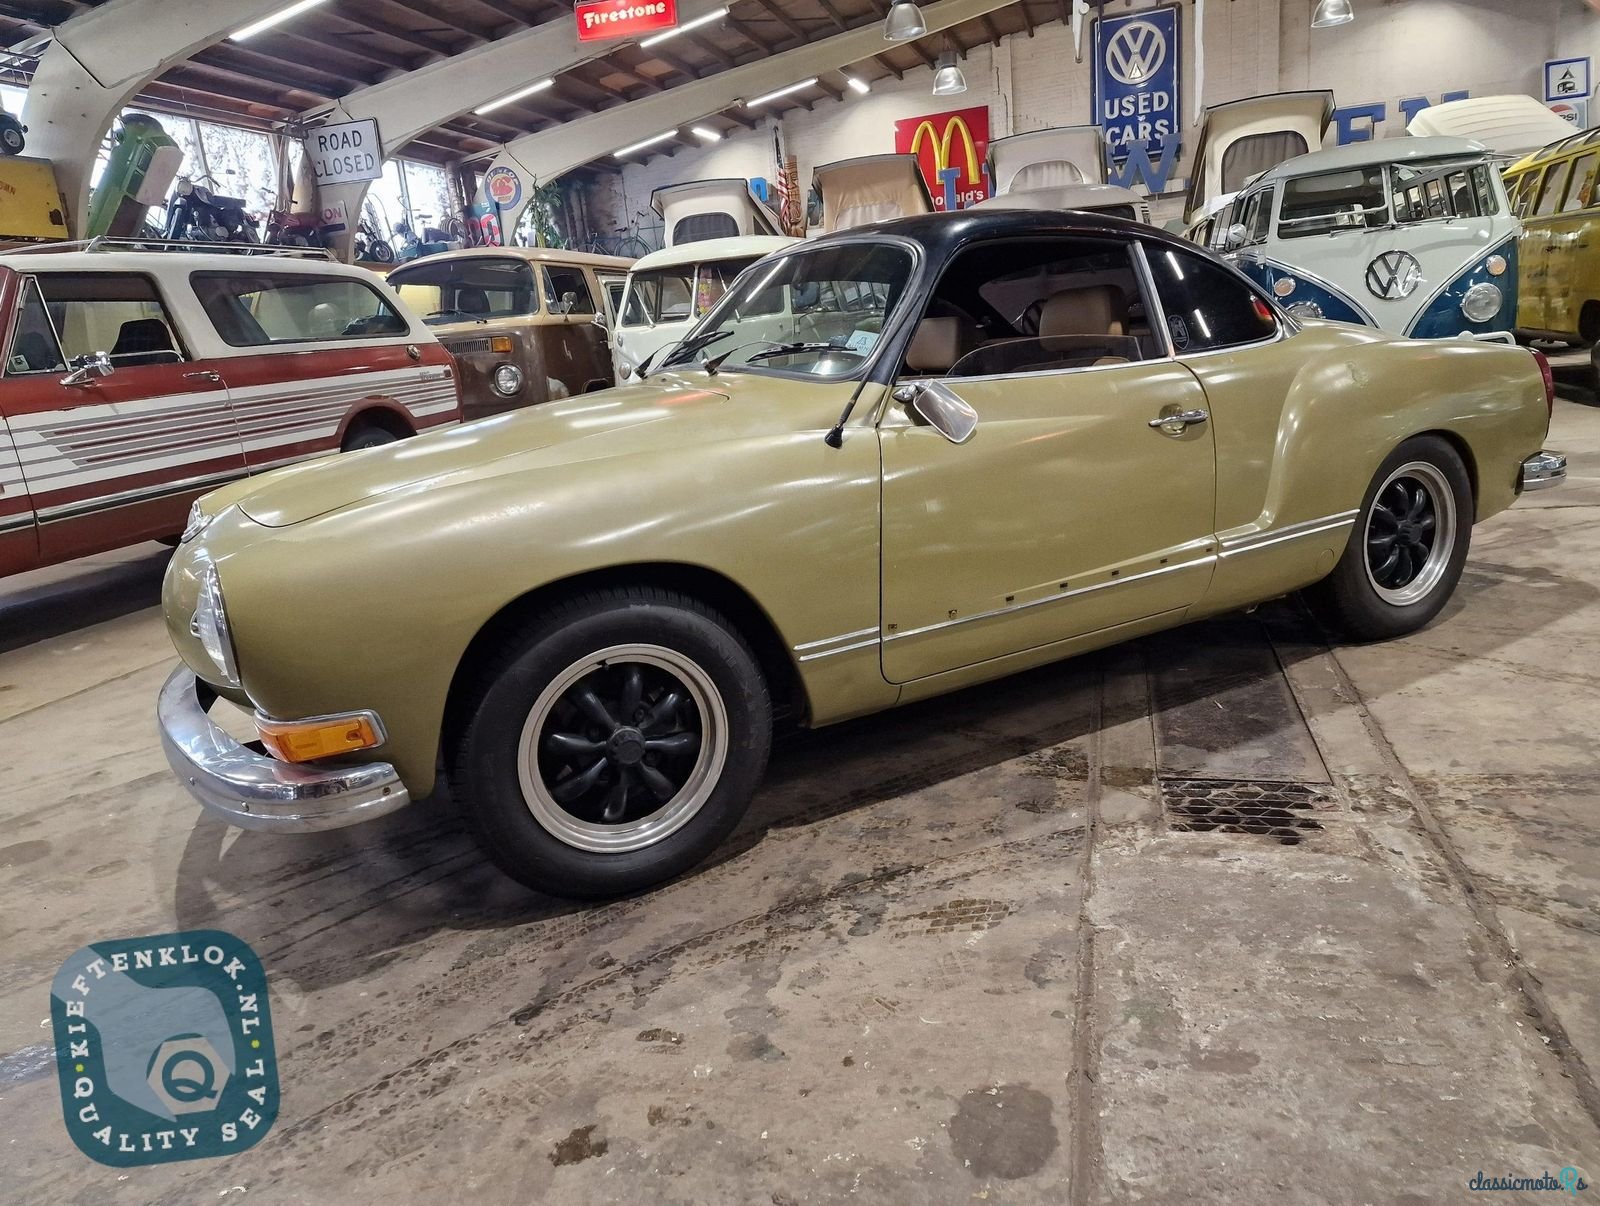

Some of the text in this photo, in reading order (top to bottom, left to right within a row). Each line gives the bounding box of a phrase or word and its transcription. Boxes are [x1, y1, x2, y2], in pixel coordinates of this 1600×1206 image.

[583, 2, 666, 28] Firestone
[1104, 90, 1170, 119] USED
[318, 130, 362, 153] ROAD
[1105, 119, 1170, 147] CARS
[313, 153, 375, 178] CLOSED
